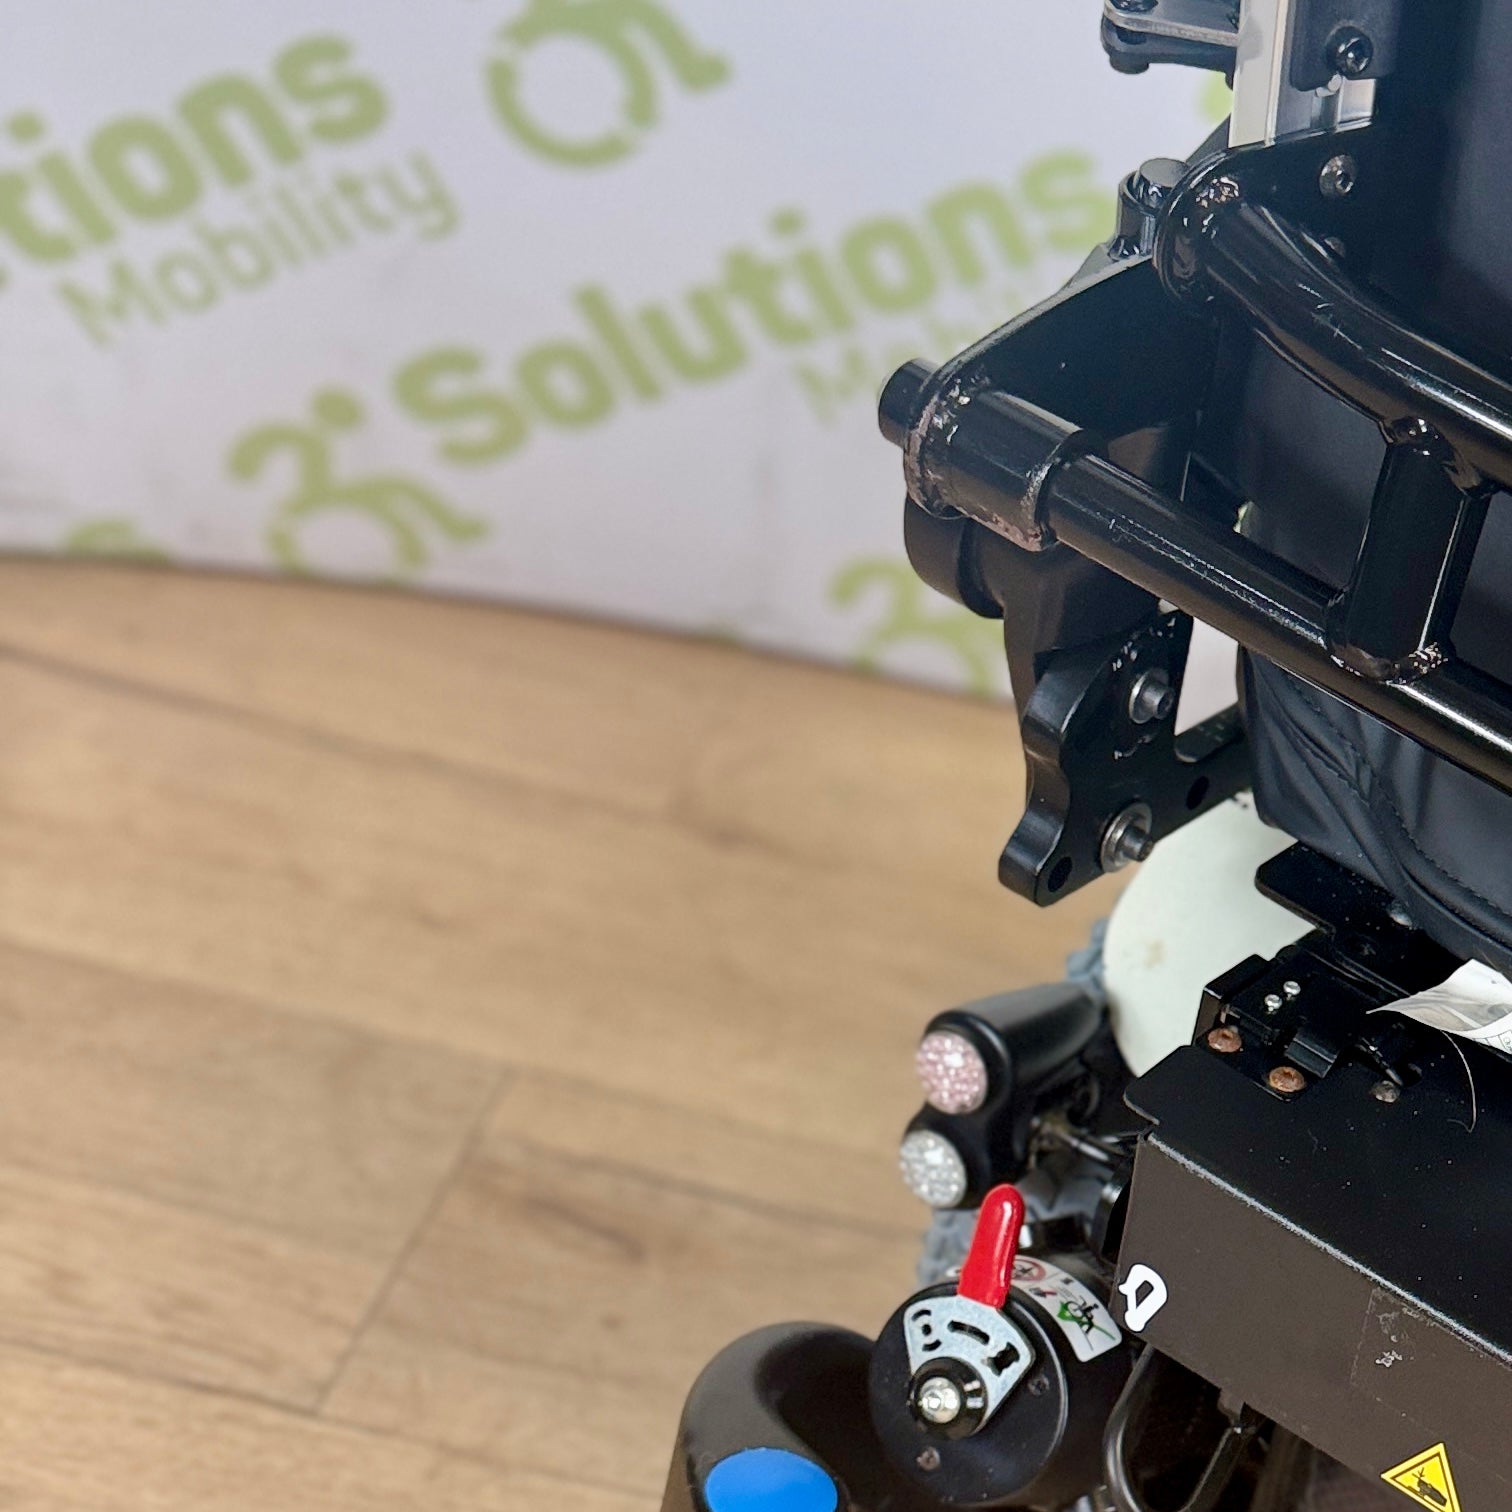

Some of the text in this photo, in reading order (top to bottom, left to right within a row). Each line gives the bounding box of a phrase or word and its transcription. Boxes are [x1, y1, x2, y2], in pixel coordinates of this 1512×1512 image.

[0, 32, 389, 265] tions
[55, 150, 462, 349] Mobility
[391, 147, 1116, 467] Solutions
